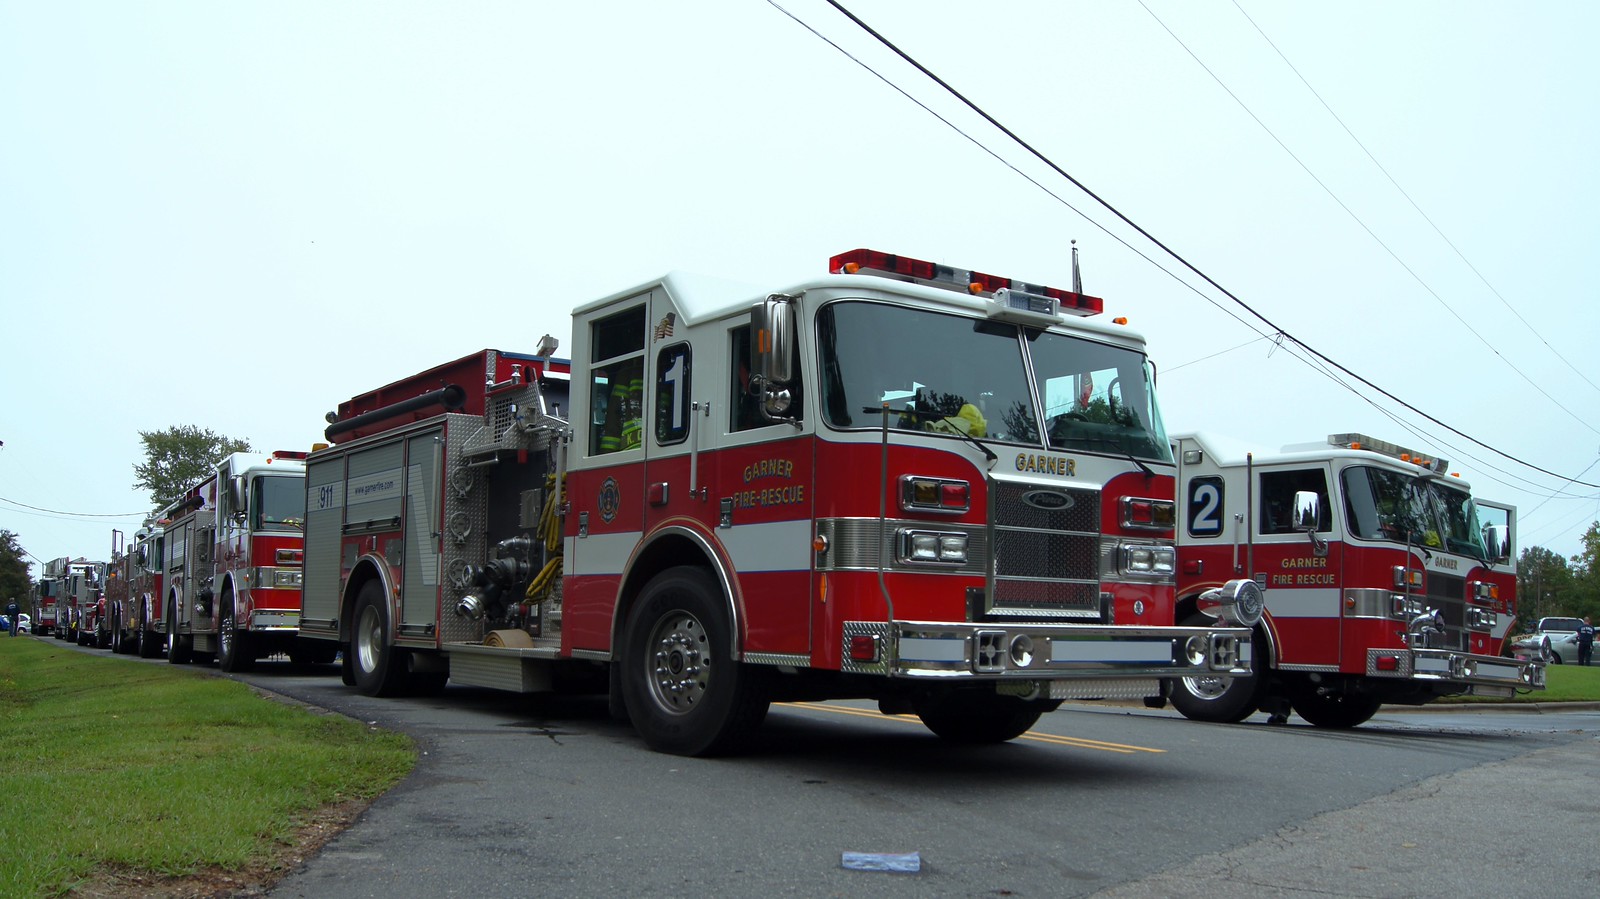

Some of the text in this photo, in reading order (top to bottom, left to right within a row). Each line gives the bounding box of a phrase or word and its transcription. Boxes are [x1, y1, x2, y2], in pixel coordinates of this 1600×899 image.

[665, 355, 684, 429] 1
[744, 459, 793, 483] GARNER
[1015, 453, 1076, 477] GARNER
[320, 485, 334, 509] 911
[733, 485, 804, 509] FIRE-RESCUE
[1193, 484, 1219, 530] 2
[1281, 557, 1327, 568] GARNER
[1435, 556, 1458, 570] GARNER
[1272, 574, 1335, 585] FIRE RESCUE
